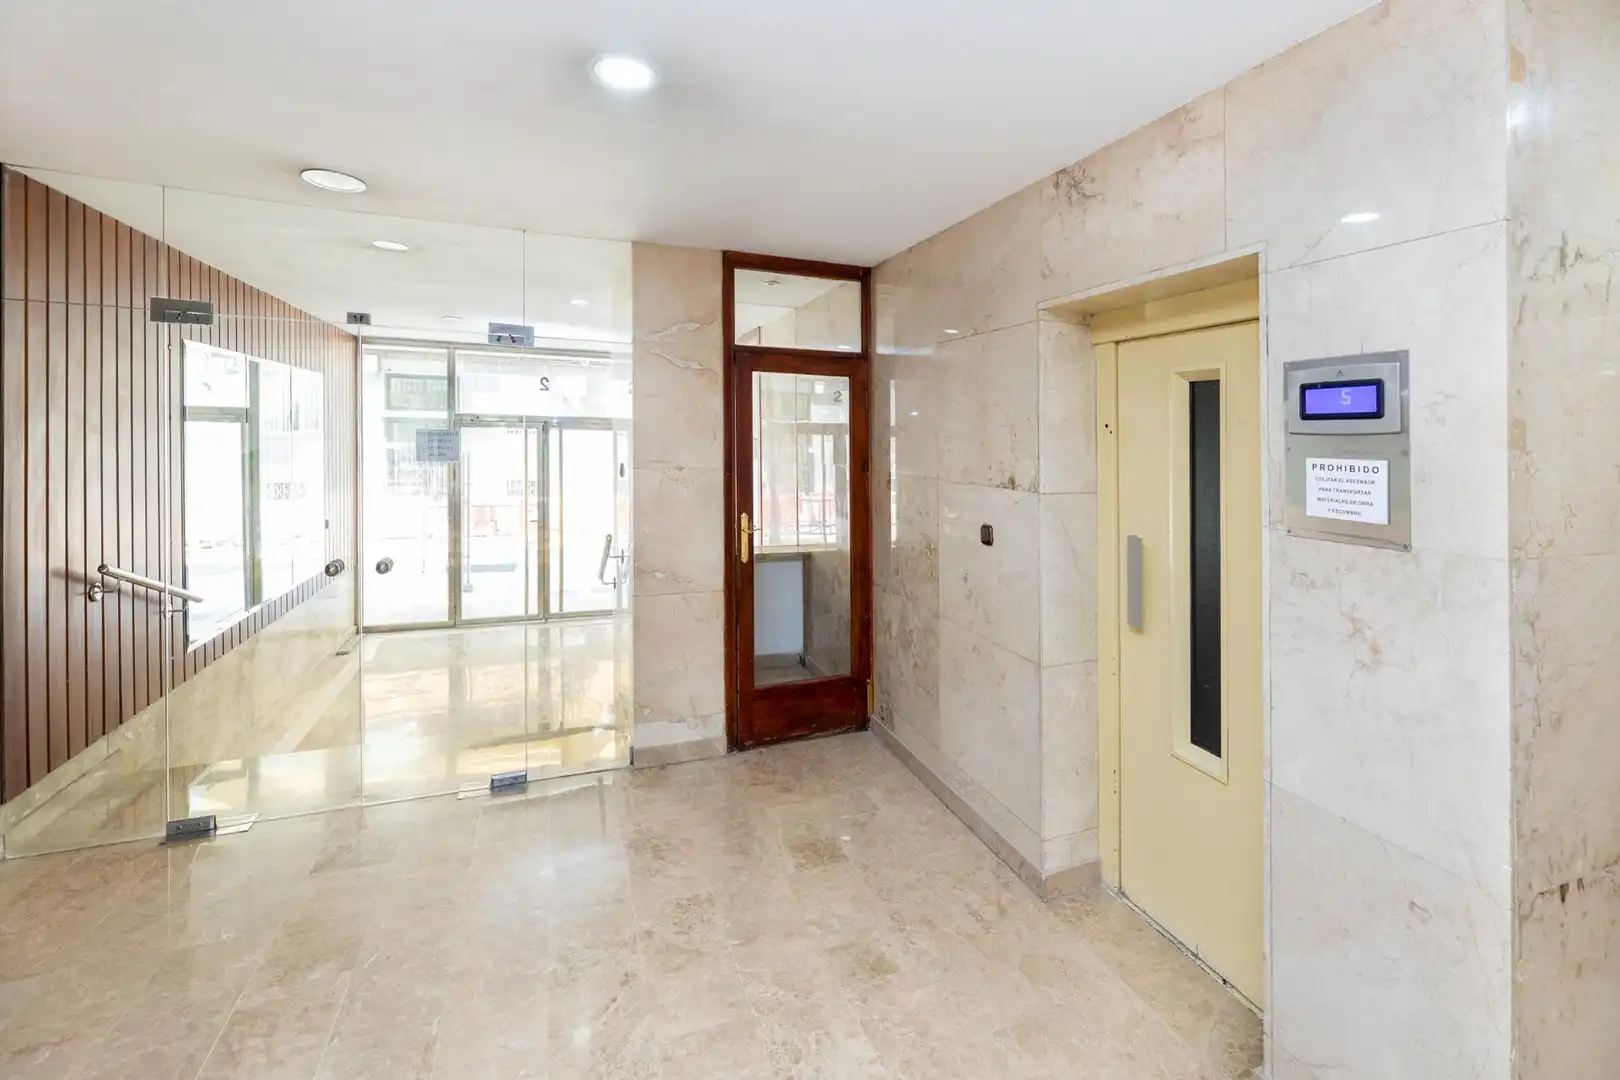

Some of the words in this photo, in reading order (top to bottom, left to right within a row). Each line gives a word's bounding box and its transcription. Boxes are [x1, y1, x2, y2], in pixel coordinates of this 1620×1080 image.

[1341, 388, 1352, 405] 5
[1312, 463, 1380, 474] PROHIBIDO
[1333, 488, 1372, 496] TRANSPORTAR
[1316, 497, 1349, 505] MATERIALES
